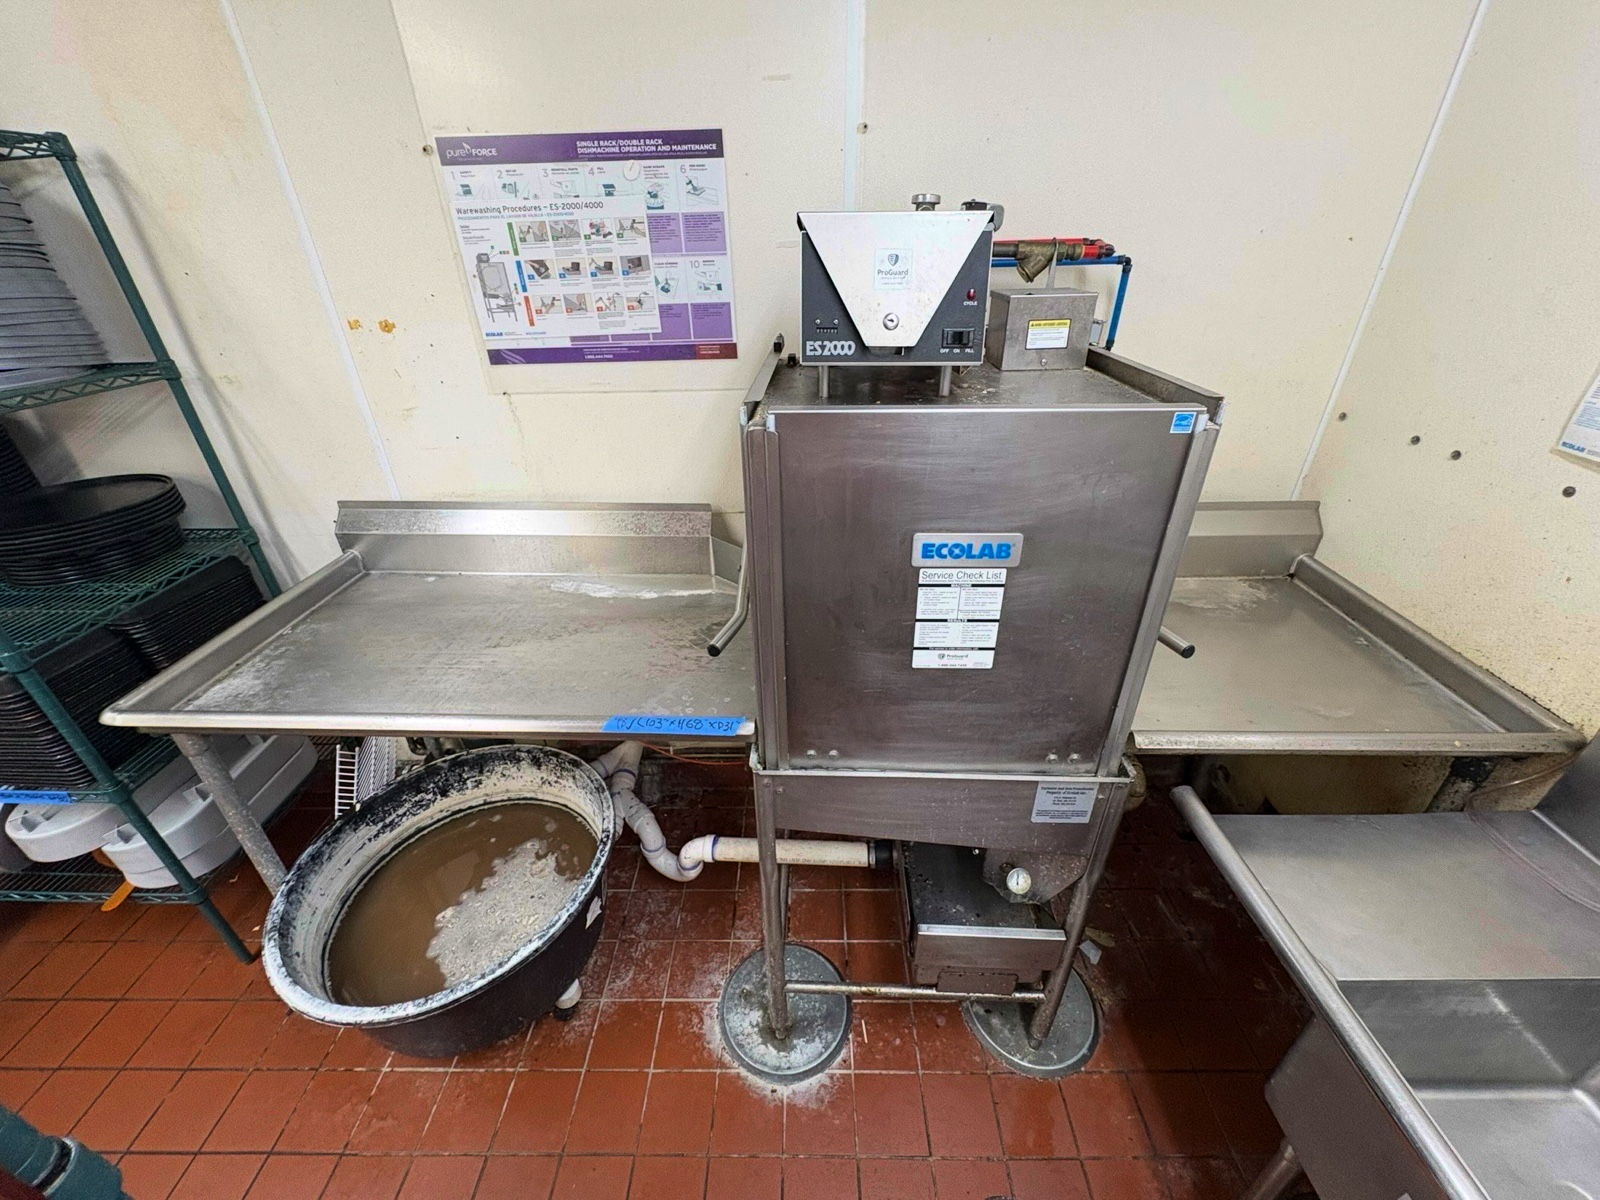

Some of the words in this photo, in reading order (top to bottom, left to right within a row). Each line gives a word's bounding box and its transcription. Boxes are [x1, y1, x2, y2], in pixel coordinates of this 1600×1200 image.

[472, 148, 497, 156] FORCE
[542, 168, 548, 177] 3
[588, 168, 594, 176] 4
[680, 165, 686, 173] 6
[497, 170, 503, 179] 2
[456, 206, 500, 215] Warewashing
[502, 203, 542, 212] Procedures
[550, 201, 603, 211] ES-2000/4000
[690, 260, 699, 268] 10
[806, 340, 856, 355] ES2000
[922, 543, 1011, 559] ECOLAB
[922, 571, 953, 580] Service
[956, 571, 983, 580] Check
[986, 571, 1001, 579] List
